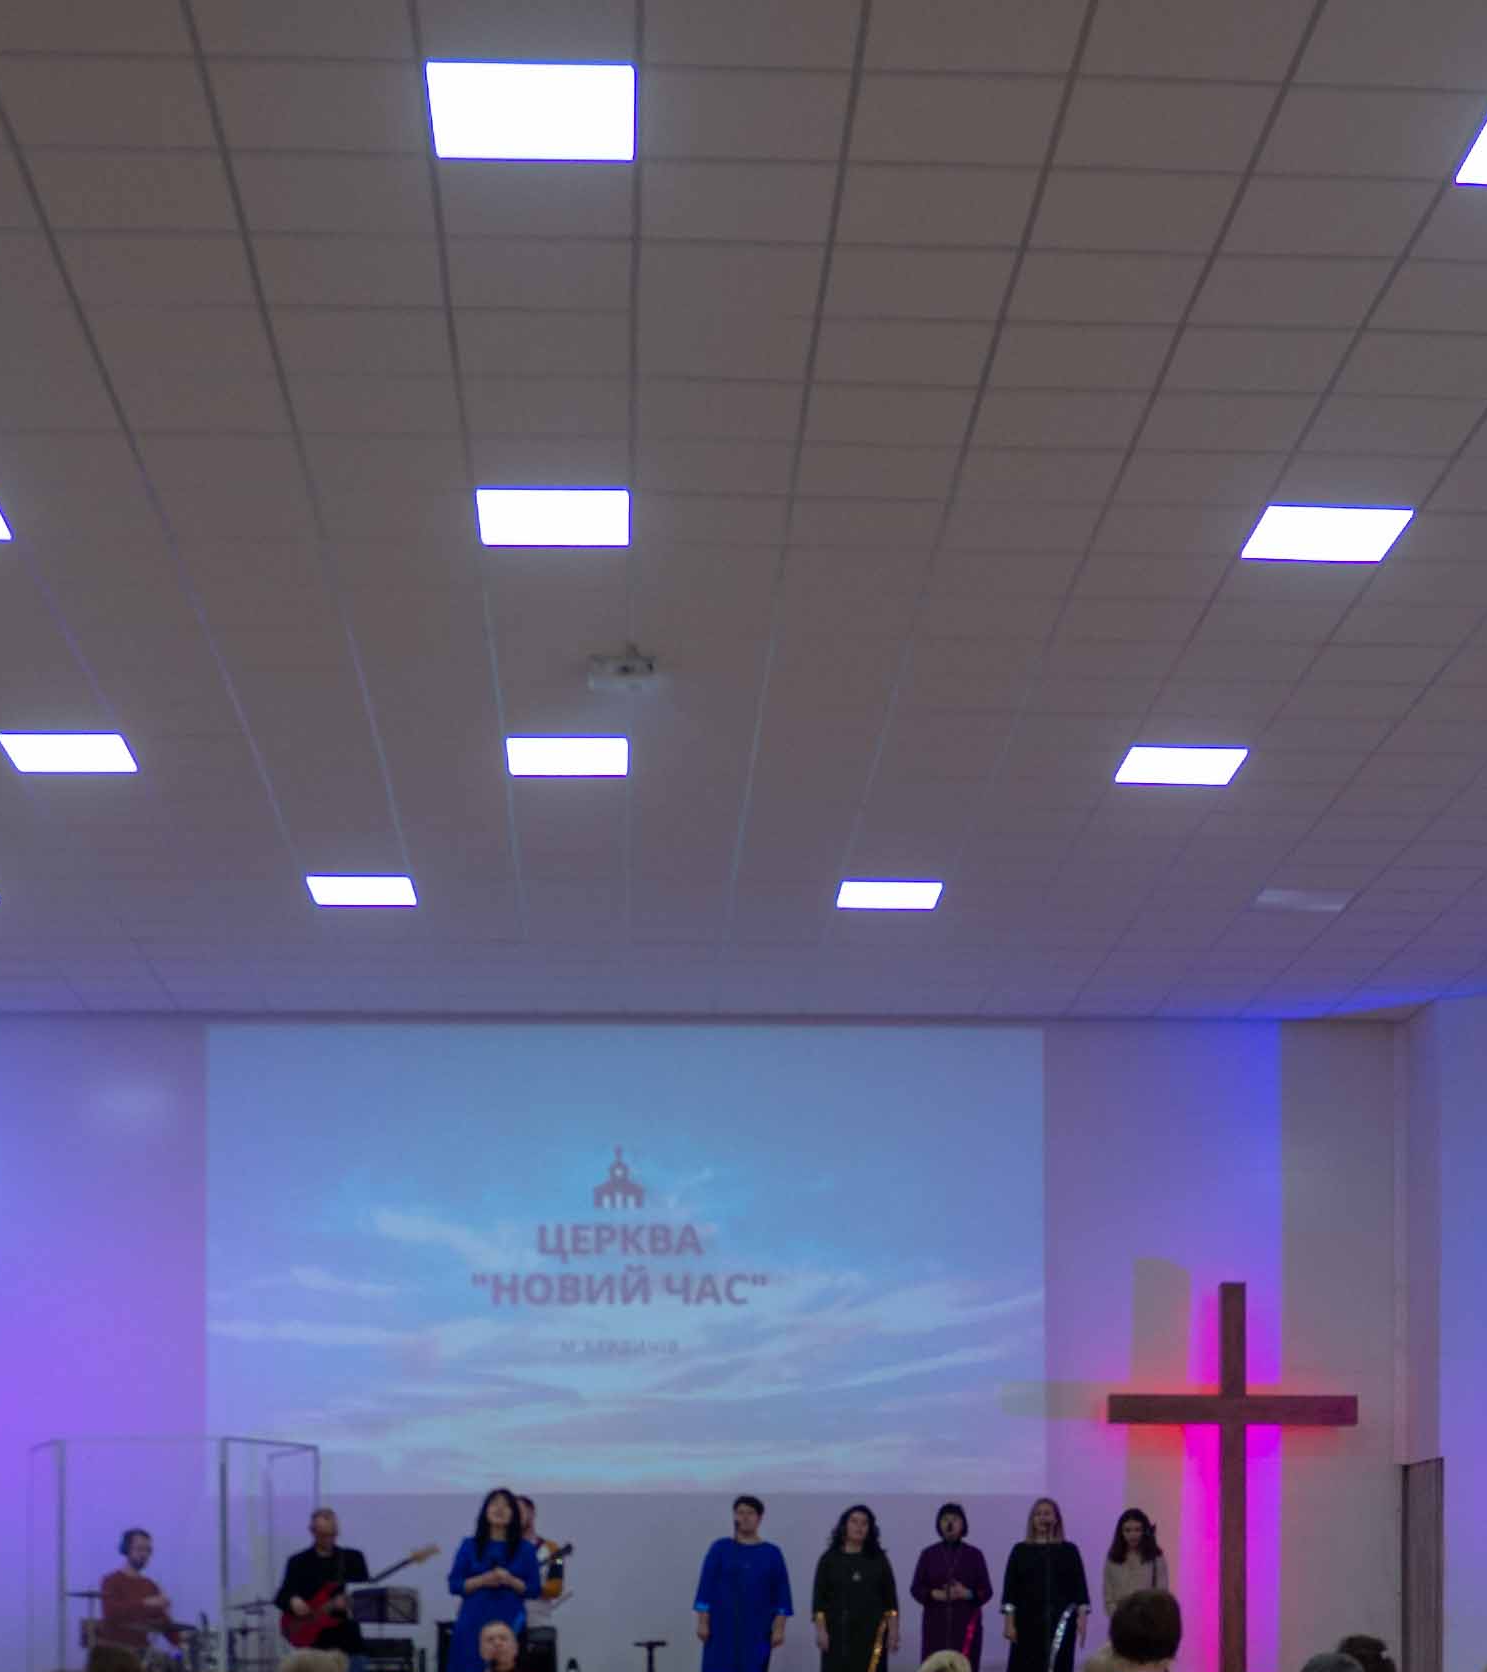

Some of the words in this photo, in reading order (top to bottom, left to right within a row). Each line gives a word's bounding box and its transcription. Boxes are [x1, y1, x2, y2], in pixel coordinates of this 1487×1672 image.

[536, 1223, 705, 1263] ЦЕРКВА
[471, 1265, 651, 1306] "НОВИЙ
[664, 1272, 769, 1306] ЧАС"
